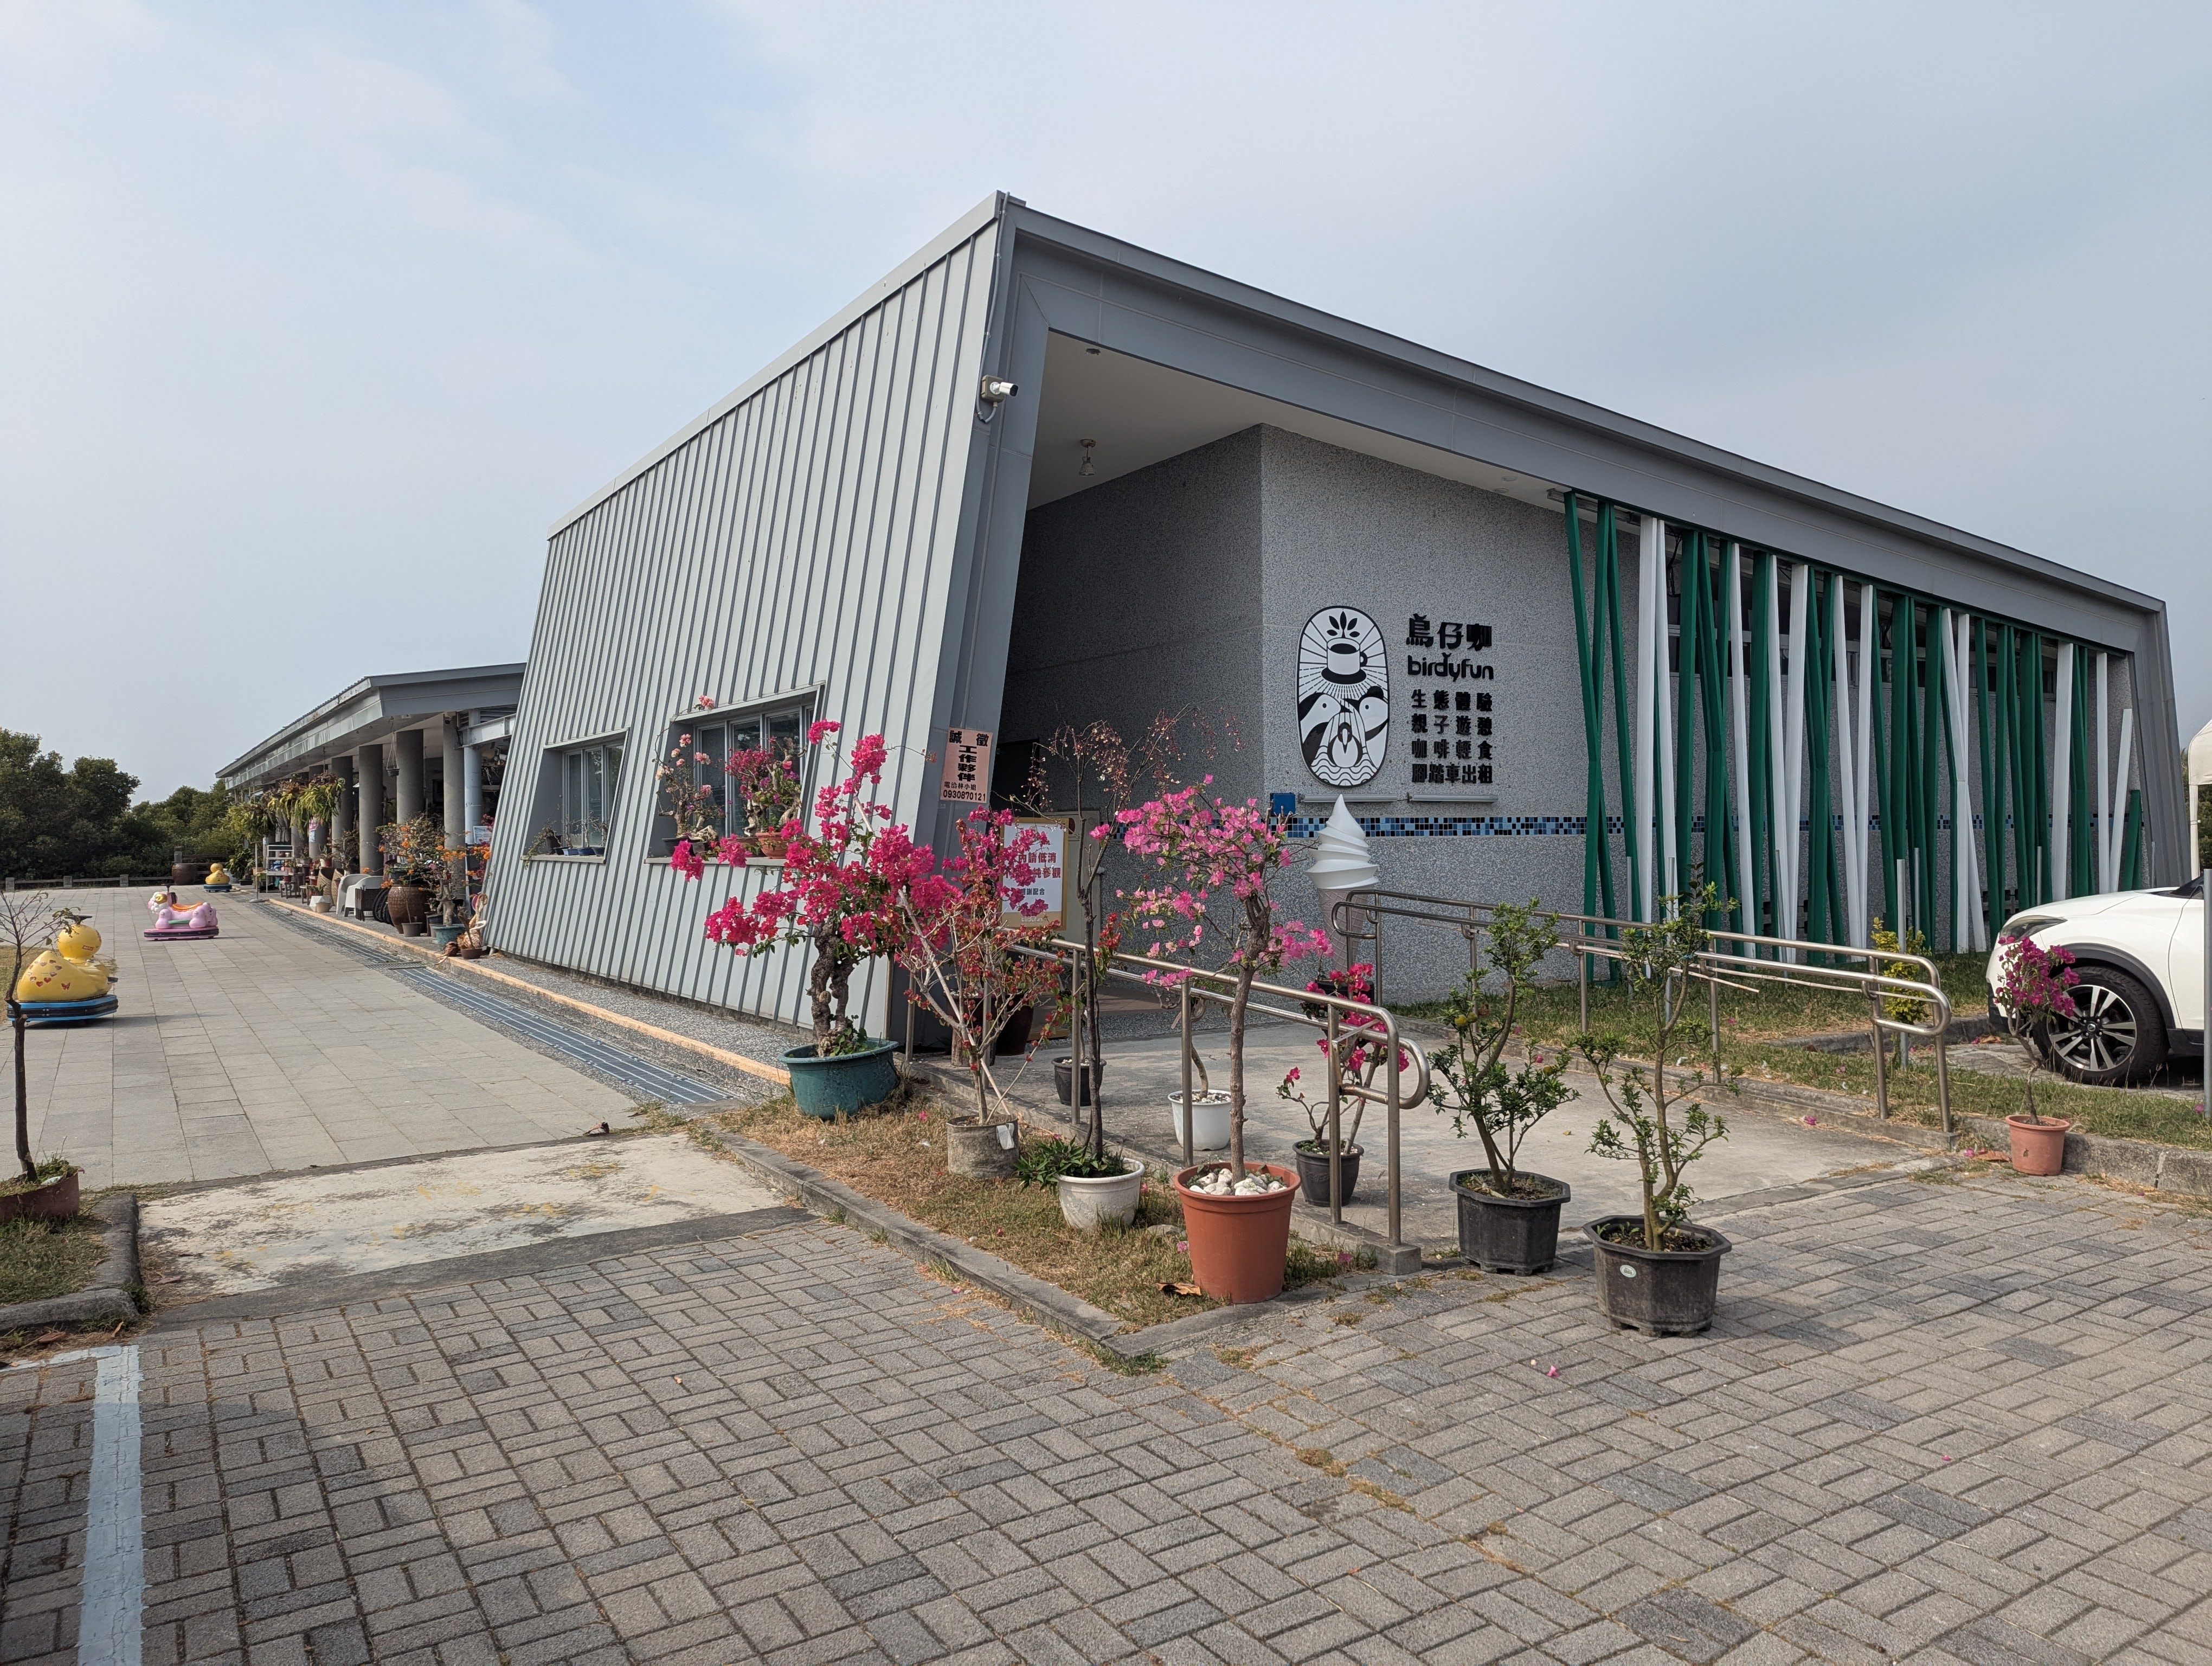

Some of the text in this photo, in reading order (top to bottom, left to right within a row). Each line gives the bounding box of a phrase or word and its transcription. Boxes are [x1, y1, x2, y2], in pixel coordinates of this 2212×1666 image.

[1406, 613, 1492, 651] 鳥仔咖
[1407, 652, 1494, 682] birdyfun
[1411, 689, 1493, 712] 生態體驗
[1411, 713, 1493, 735] 親子遊憩
[1412, 739, 1493, 759] 咖啡輕食
[957, 745, 977, 781] 工作夥伴
[1412, 763, 1493, 784] 腳踏車出租
[943, 790, 986, 801] 0930870121
[944, 781, 976, 791] 電洽林小姐
